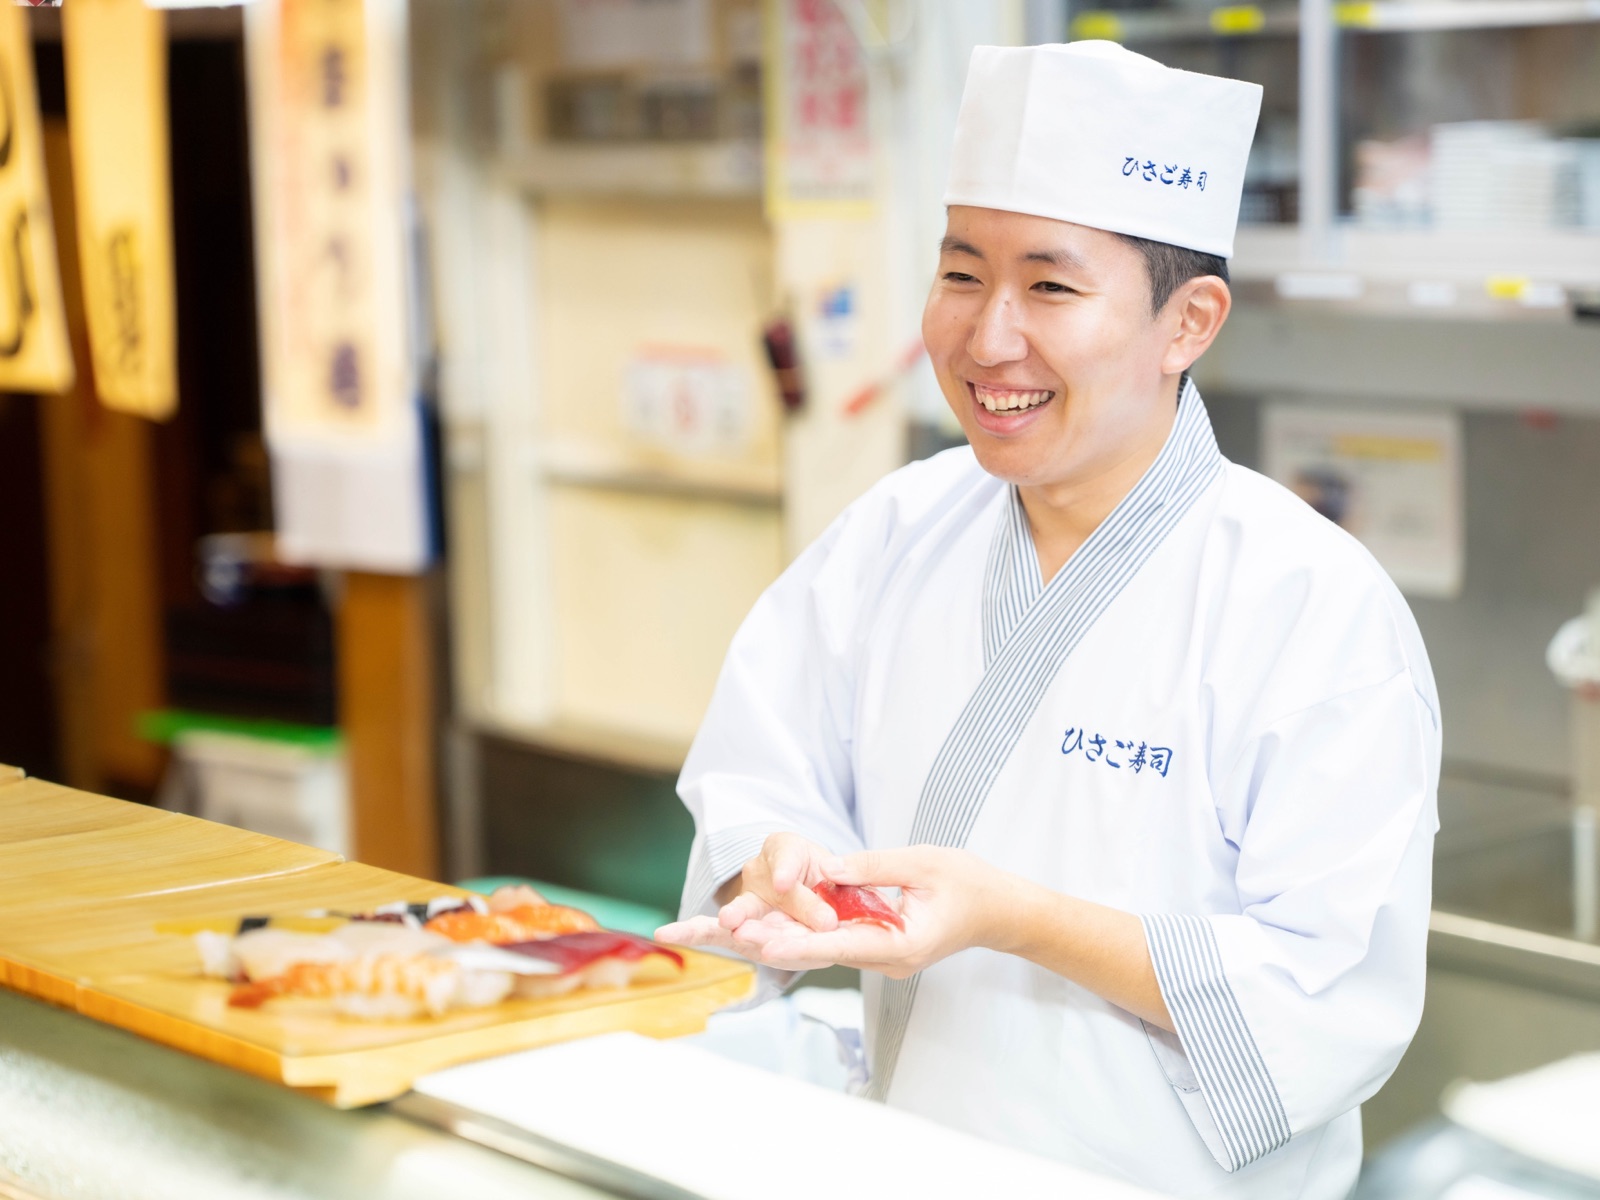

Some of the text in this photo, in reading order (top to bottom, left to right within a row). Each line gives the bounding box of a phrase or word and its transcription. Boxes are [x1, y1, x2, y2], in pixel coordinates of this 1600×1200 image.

[1121, 156, 1208, 192] ひさご寿司
[1061, 726, 1173, 778] ひさご寿司
